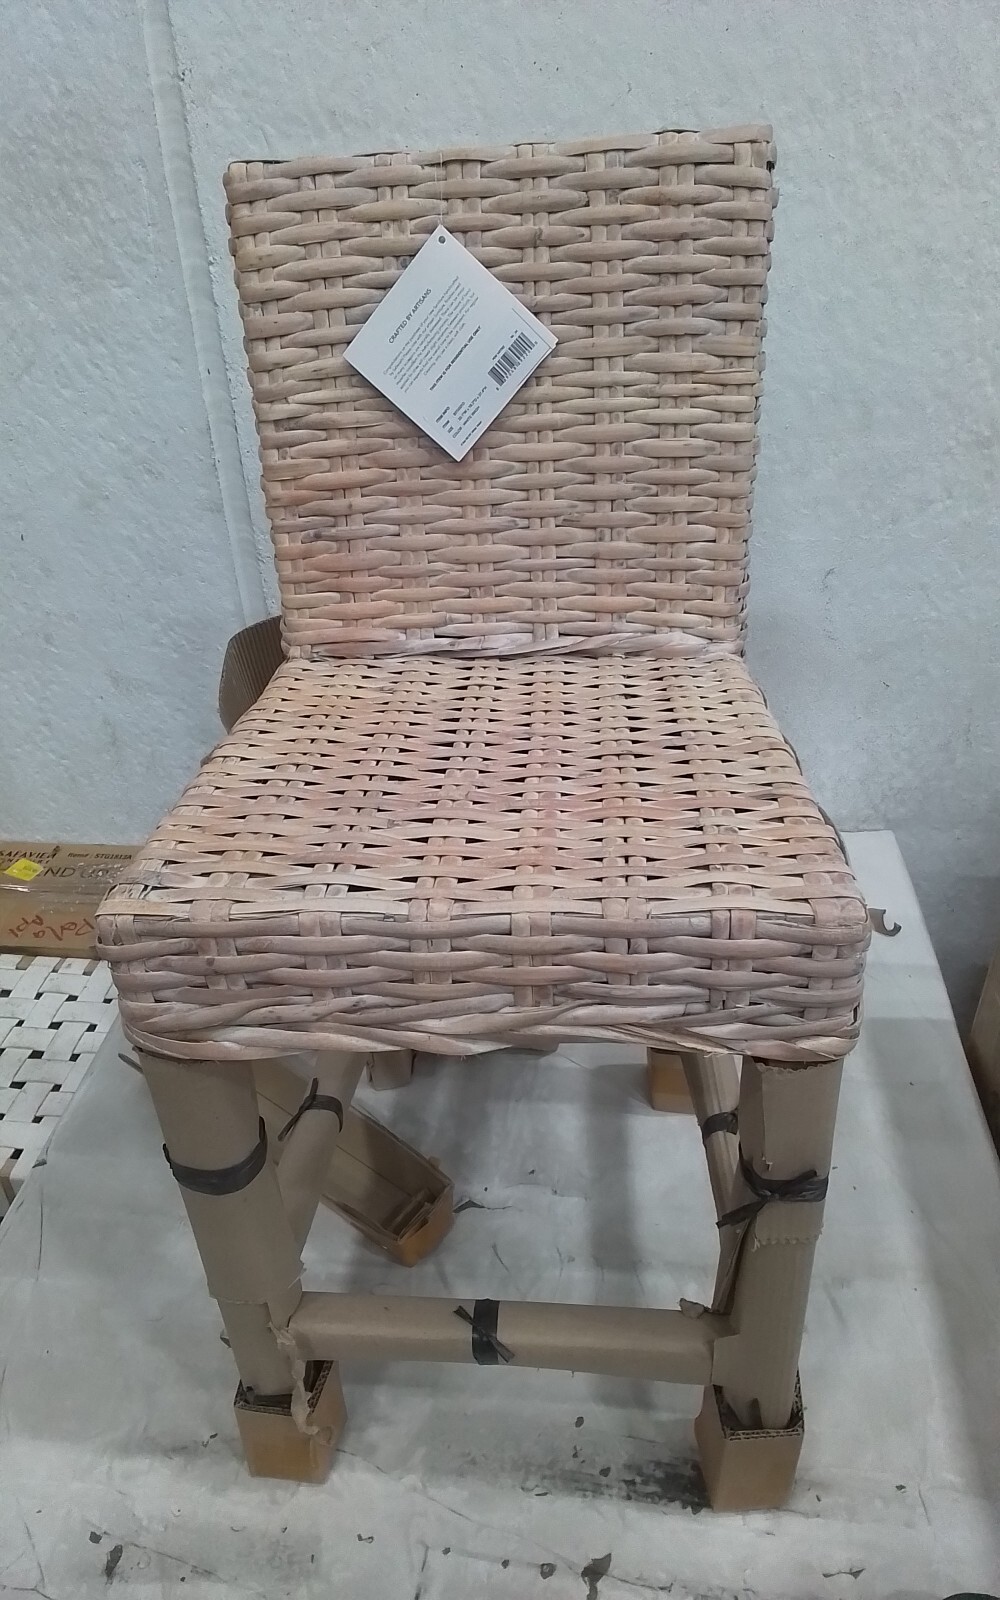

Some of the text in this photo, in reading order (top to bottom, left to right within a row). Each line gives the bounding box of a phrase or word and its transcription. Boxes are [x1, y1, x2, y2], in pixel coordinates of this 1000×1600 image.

[387, 318, 408, 344] CRAFTED
[405, 312, 413, 321] BY
[410, 287, 432, 314] ARTISANS
[444, 363, 452, 371] FOR
